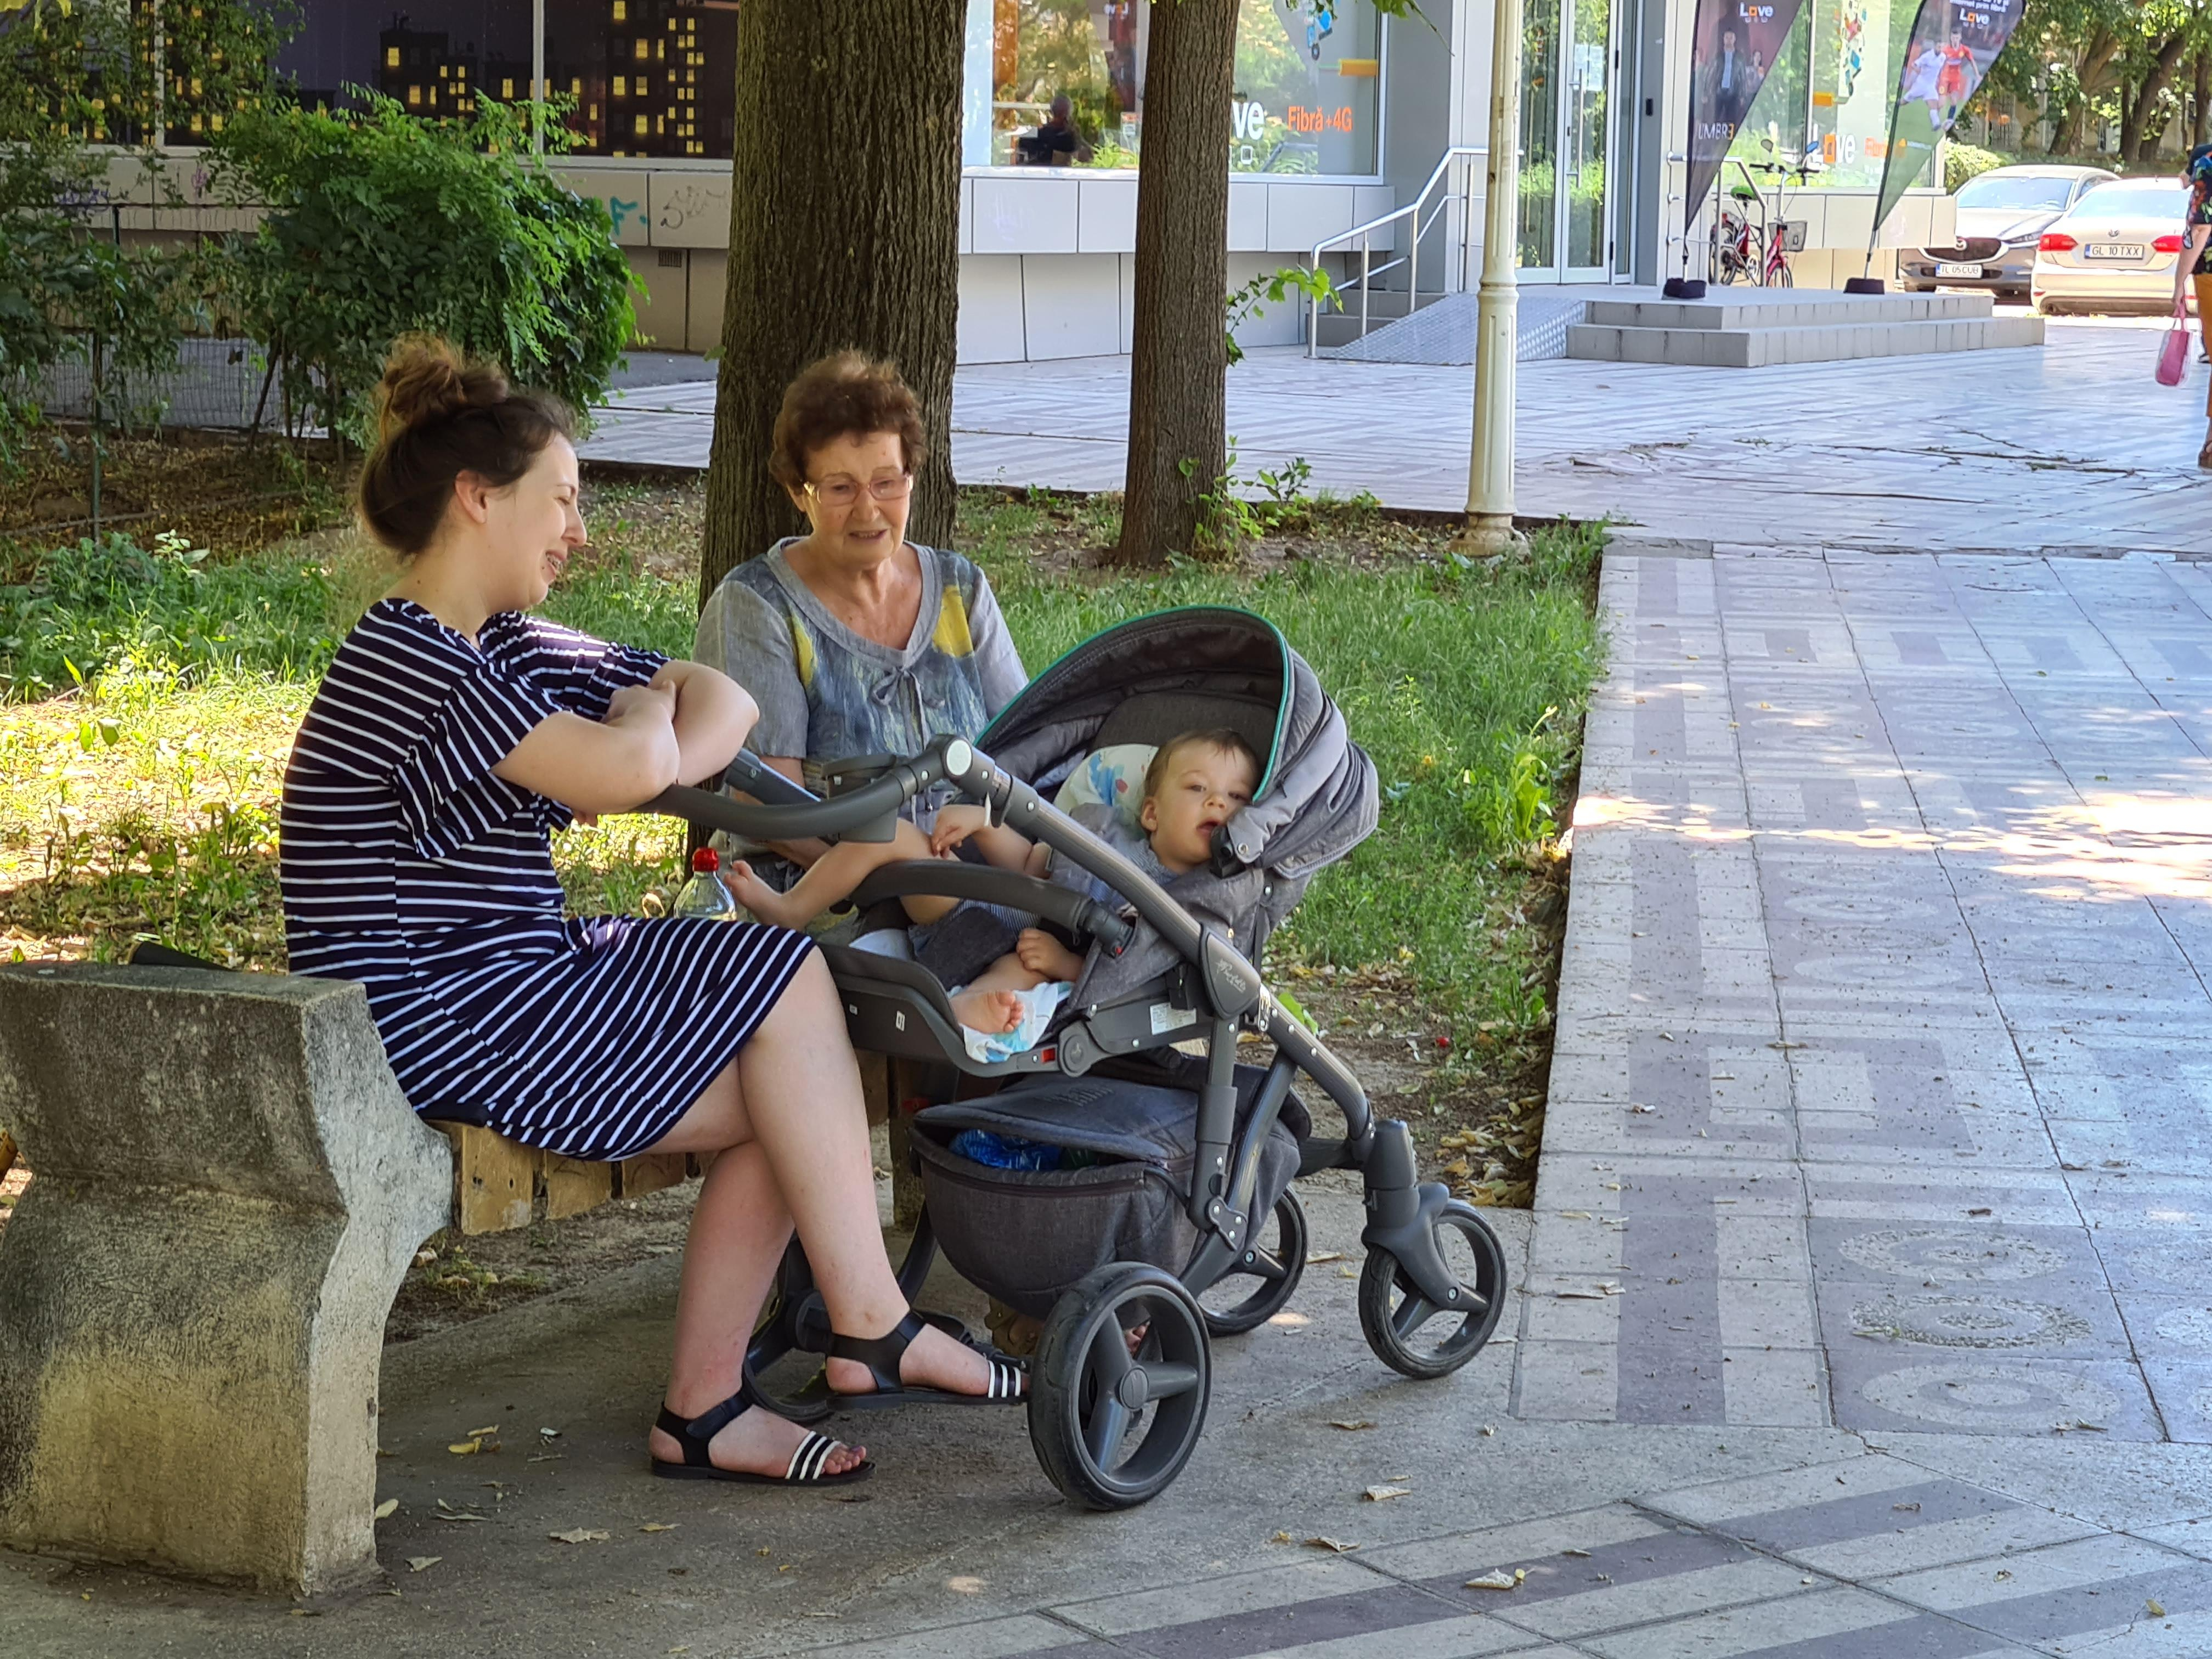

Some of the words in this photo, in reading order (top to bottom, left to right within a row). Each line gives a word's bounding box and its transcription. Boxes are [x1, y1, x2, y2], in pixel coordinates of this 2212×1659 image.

[1739, 2, 1774, 17] Love
[1959, 8, 1990, 25] Love
[1232, 101, 1264, 140] ve
[1288, 105, 1324, 132] Fibră
[2092, 246, 2104, 256] GL
[2109, 246, 2118, 256] 10
[2120, 246, 2140, 256] TXX
